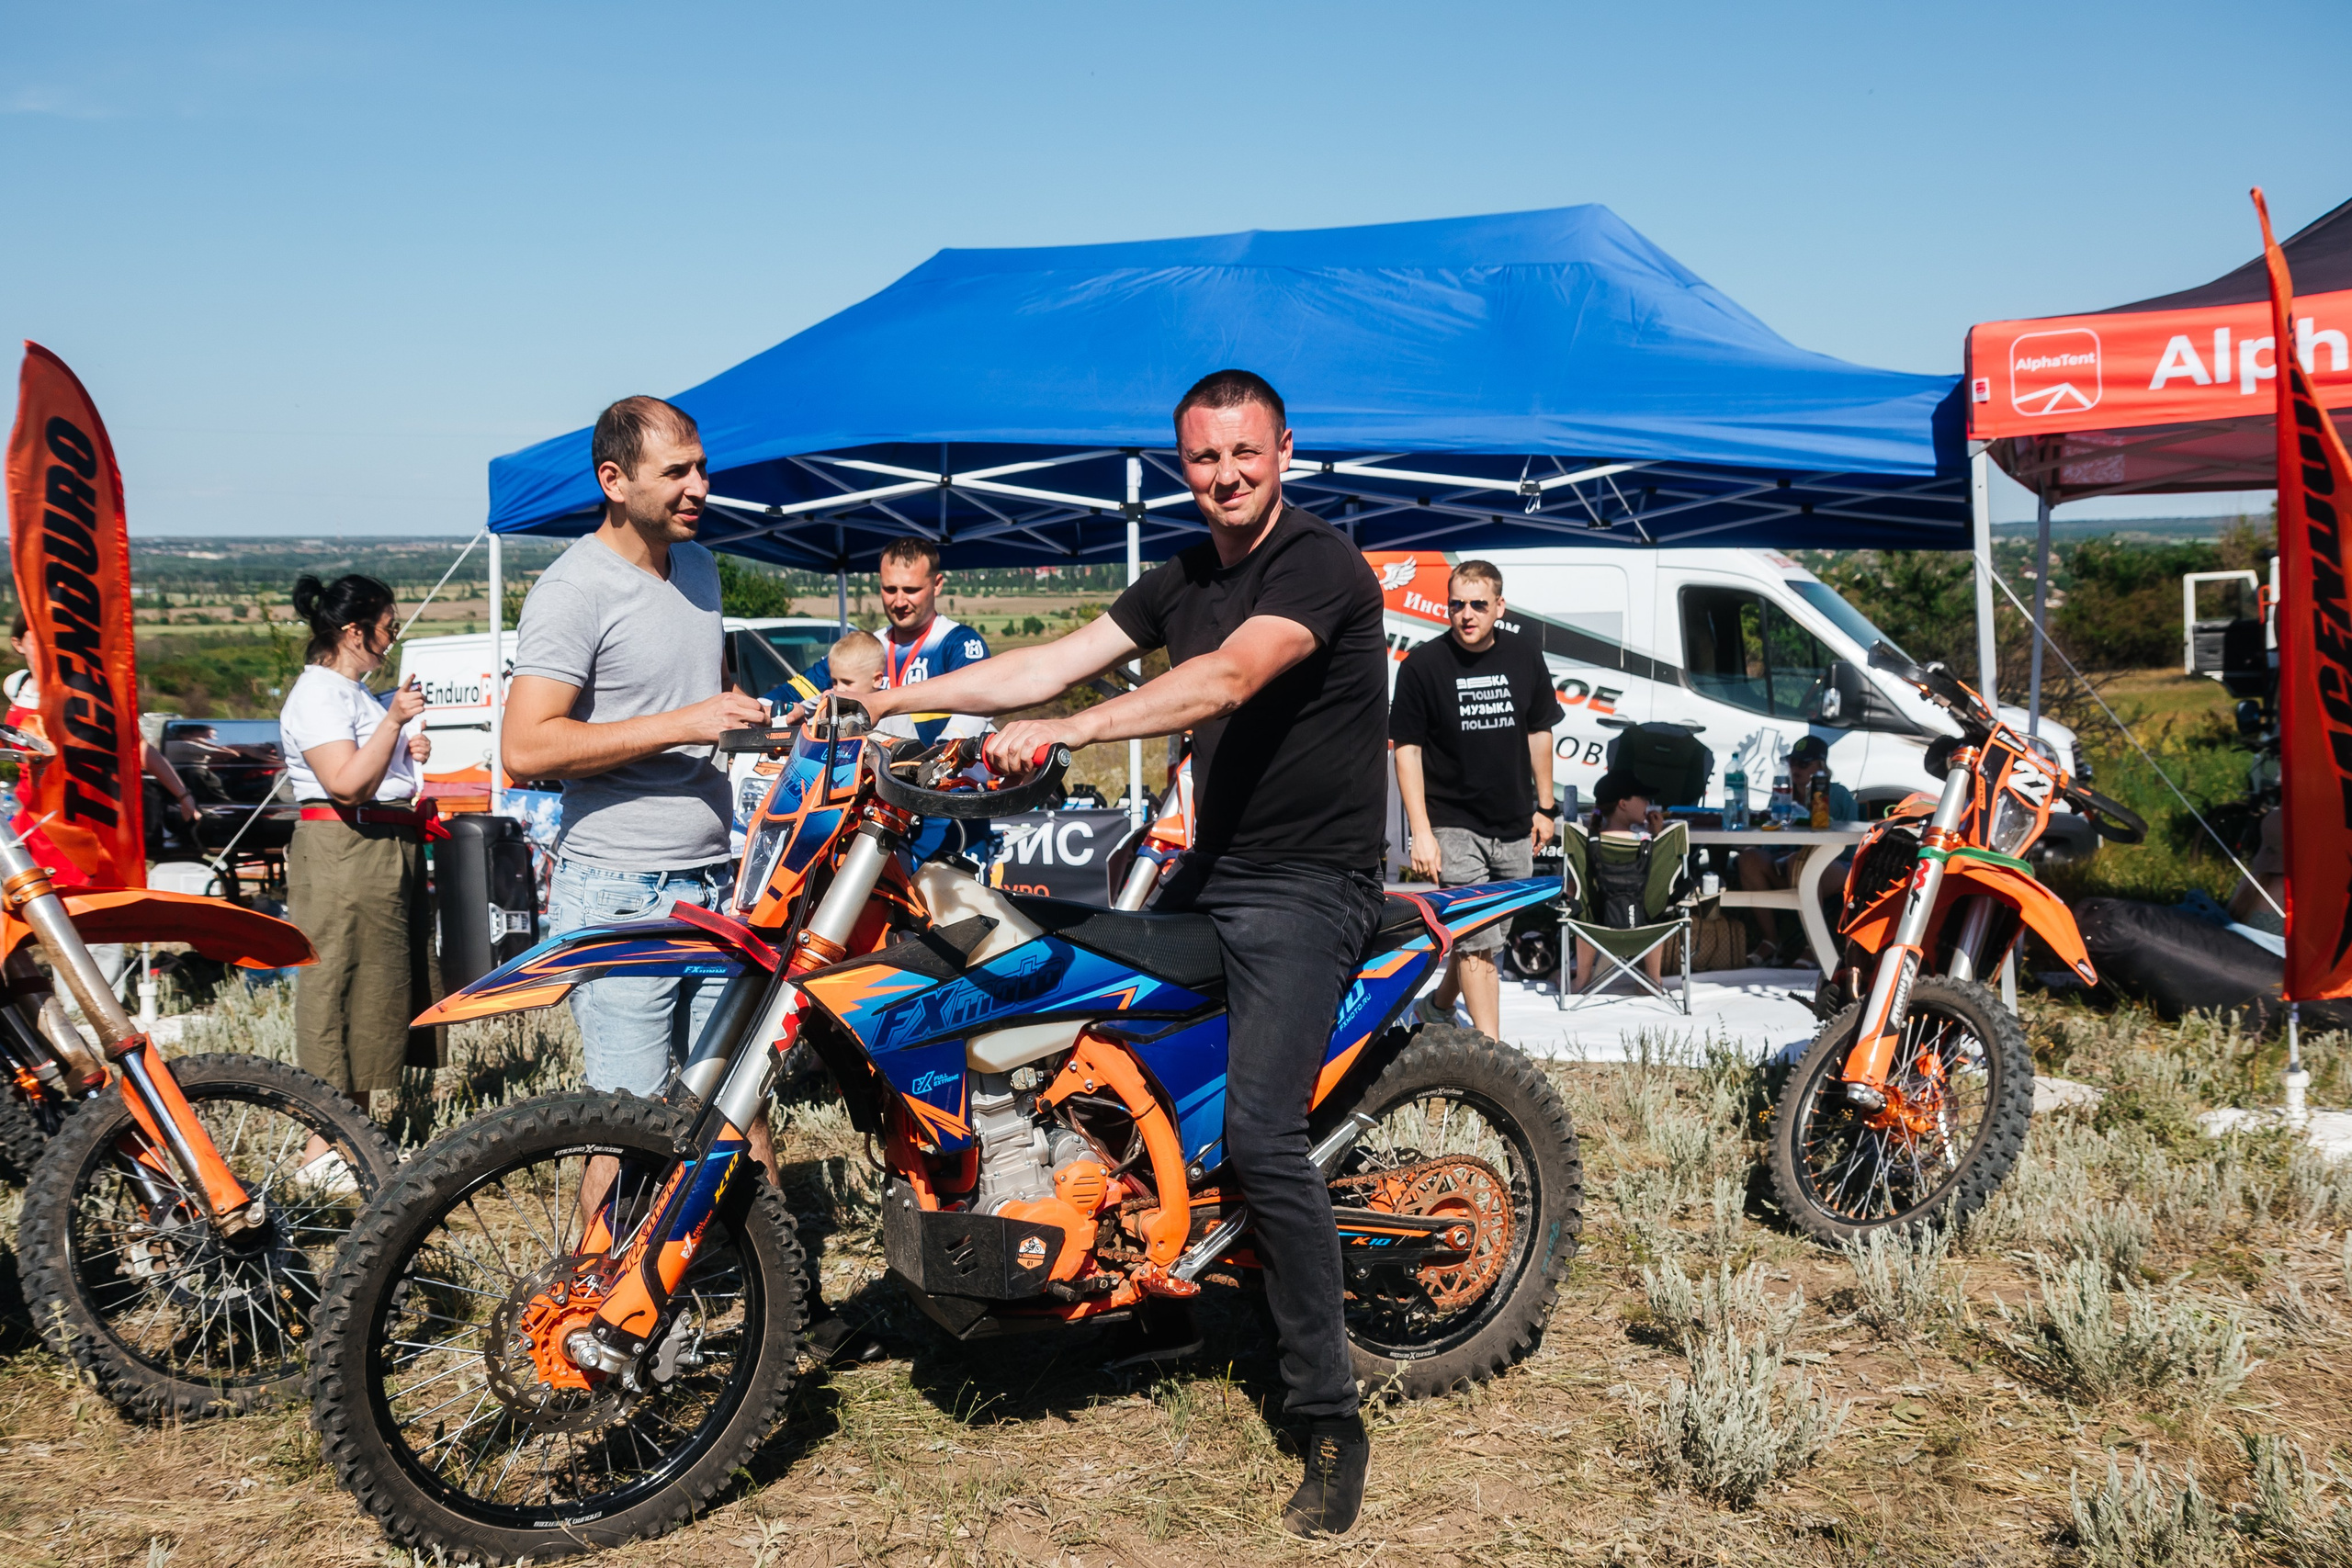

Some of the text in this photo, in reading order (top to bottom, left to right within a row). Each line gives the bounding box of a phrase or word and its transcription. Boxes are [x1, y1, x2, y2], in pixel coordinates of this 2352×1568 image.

[2014, 352, 2096, 371] AlphaTent
[44, 416, 121, 829] TAGENDURO
[1458, 688, 1511, 702] ПОШЛА
[1460, 701, 1514, 716] МУЗЫКА
[1462, 716, 1515, 730] ПОШЛА
[2007, 760, 2054, 807] 22
[1339, 992, 1372, 1032] FXMOTO.RU
[714, 1152, 740, 1205] K10
[1351, 1236, 1393, 1246] K10
